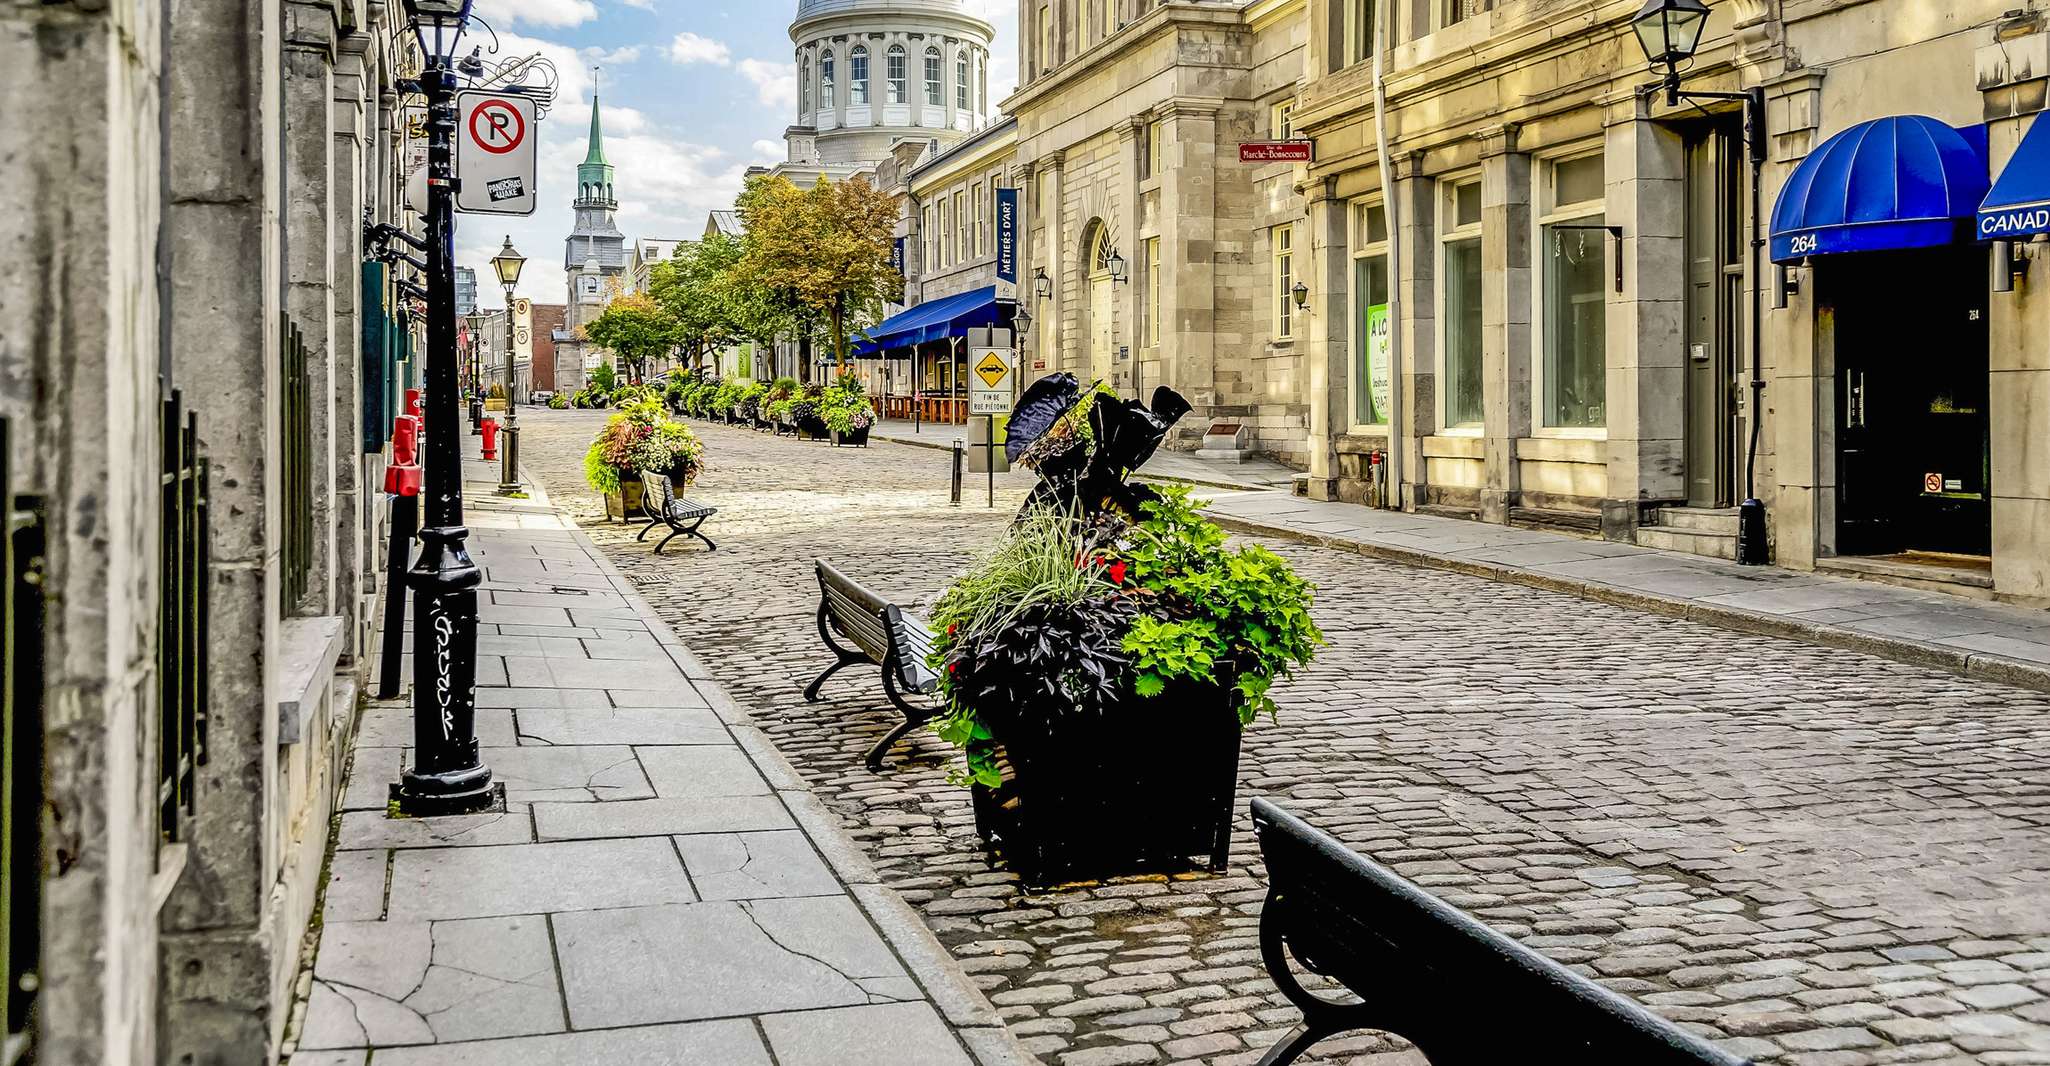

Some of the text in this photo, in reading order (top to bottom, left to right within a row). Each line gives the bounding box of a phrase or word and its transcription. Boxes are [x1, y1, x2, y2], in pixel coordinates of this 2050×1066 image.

[1981, 210, 2050, 234] CANAD
[1001, 231, 1012, 274] MÉTIERS
[1791, 233, 1817, 253] 264
